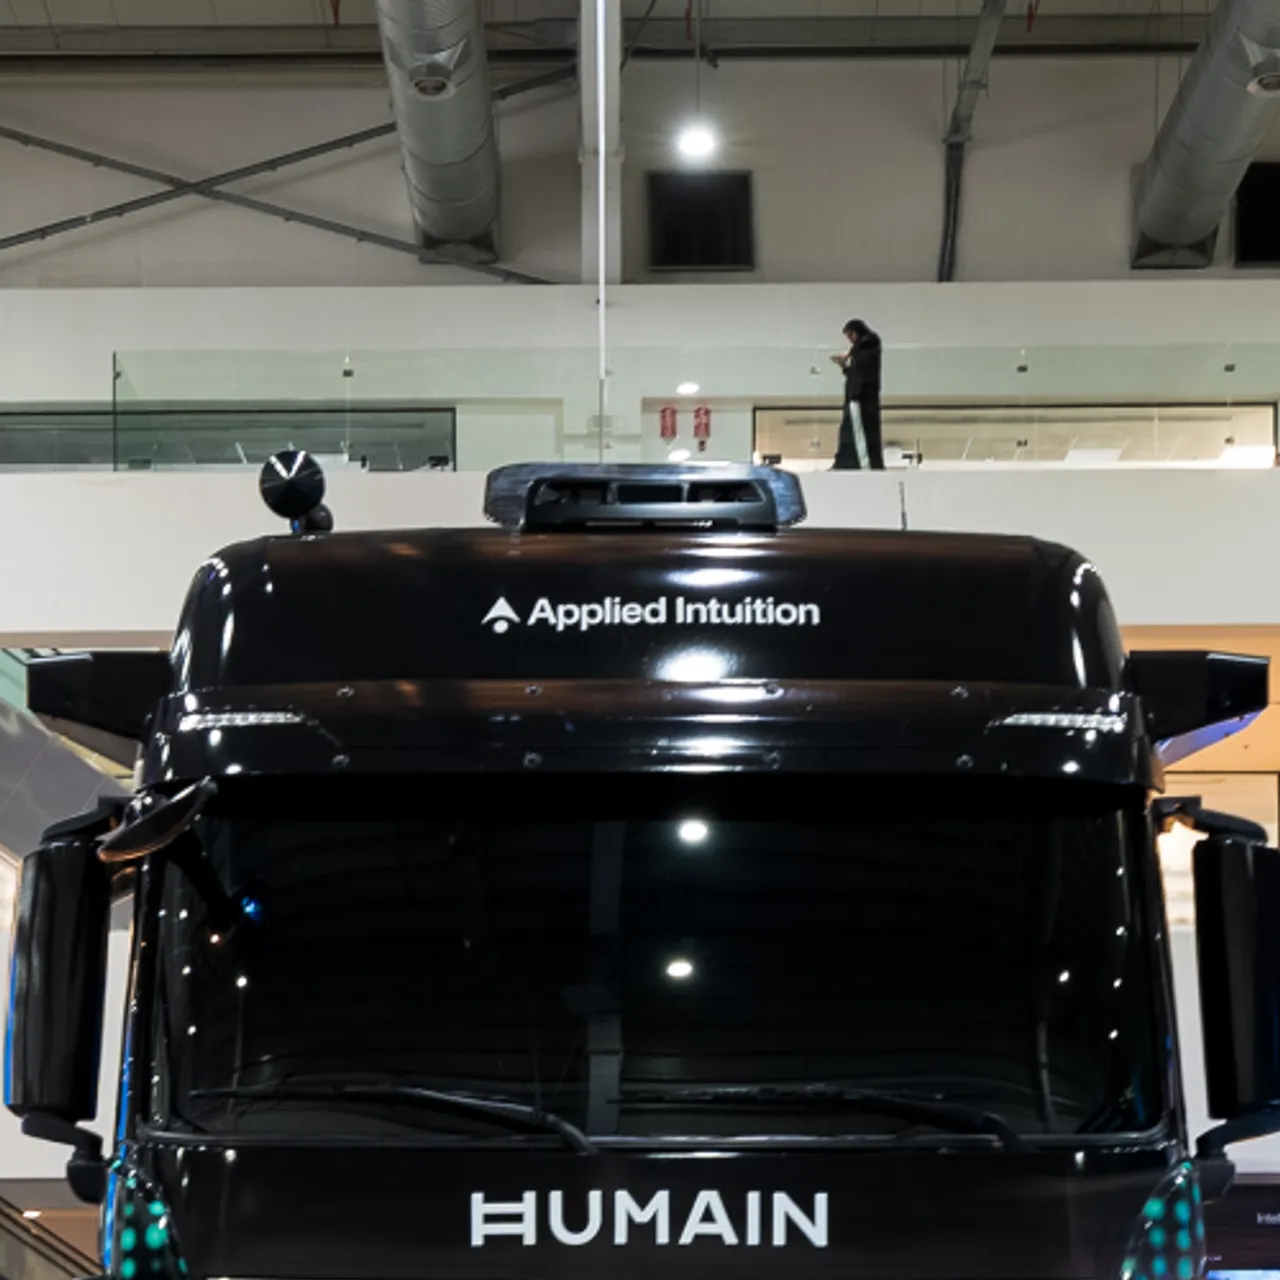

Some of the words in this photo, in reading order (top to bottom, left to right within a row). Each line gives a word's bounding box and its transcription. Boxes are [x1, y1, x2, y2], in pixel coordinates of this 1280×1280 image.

[527, 596, 667, 631] Applied
[675, 596, 821, 626] Intuition
[470, 1190, 829, 1248] HUMAIN
